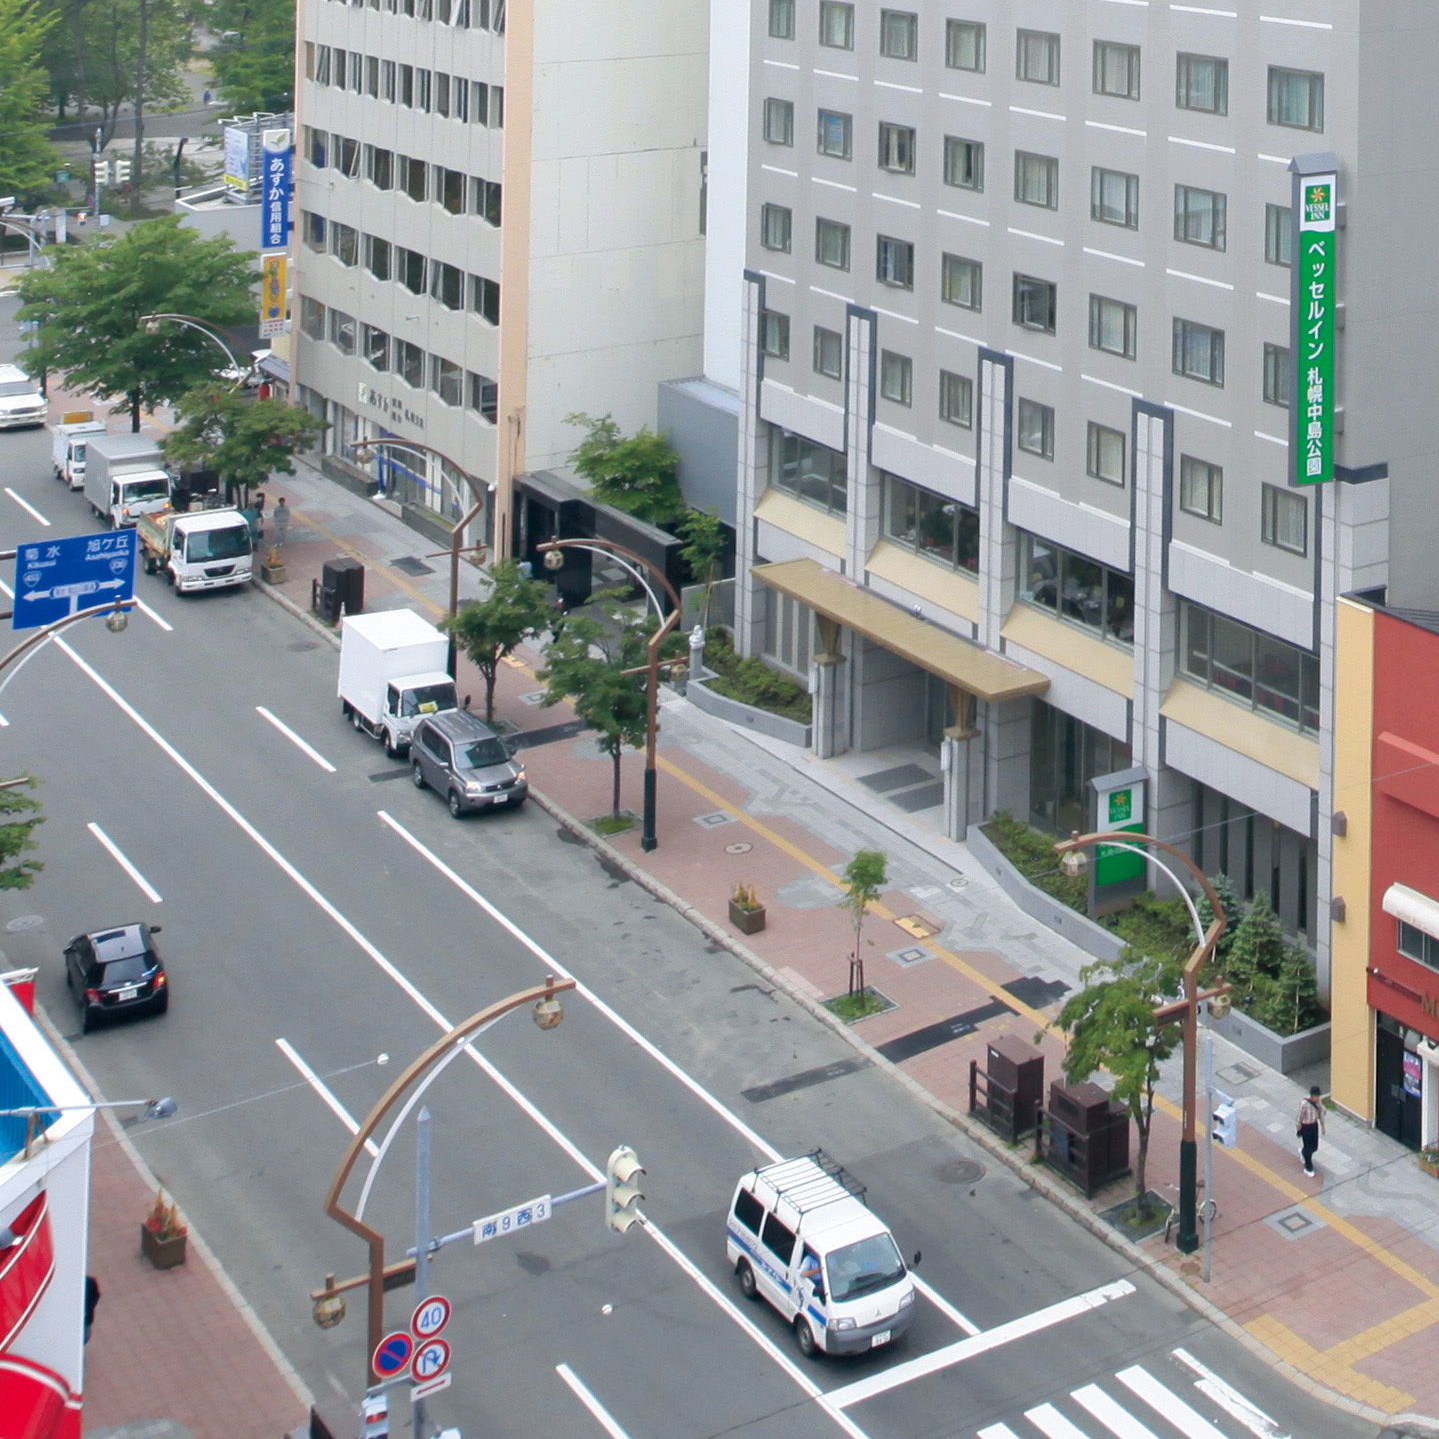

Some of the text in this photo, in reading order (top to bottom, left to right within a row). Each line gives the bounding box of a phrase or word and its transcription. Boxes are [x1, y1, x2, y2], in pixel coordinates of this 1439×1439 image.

[1307, 240, 1326, 360] ベッセルイン
[1306, 366, 1324, 477] 札幌中島公園
[420, 1307, 442, 1329] 40
